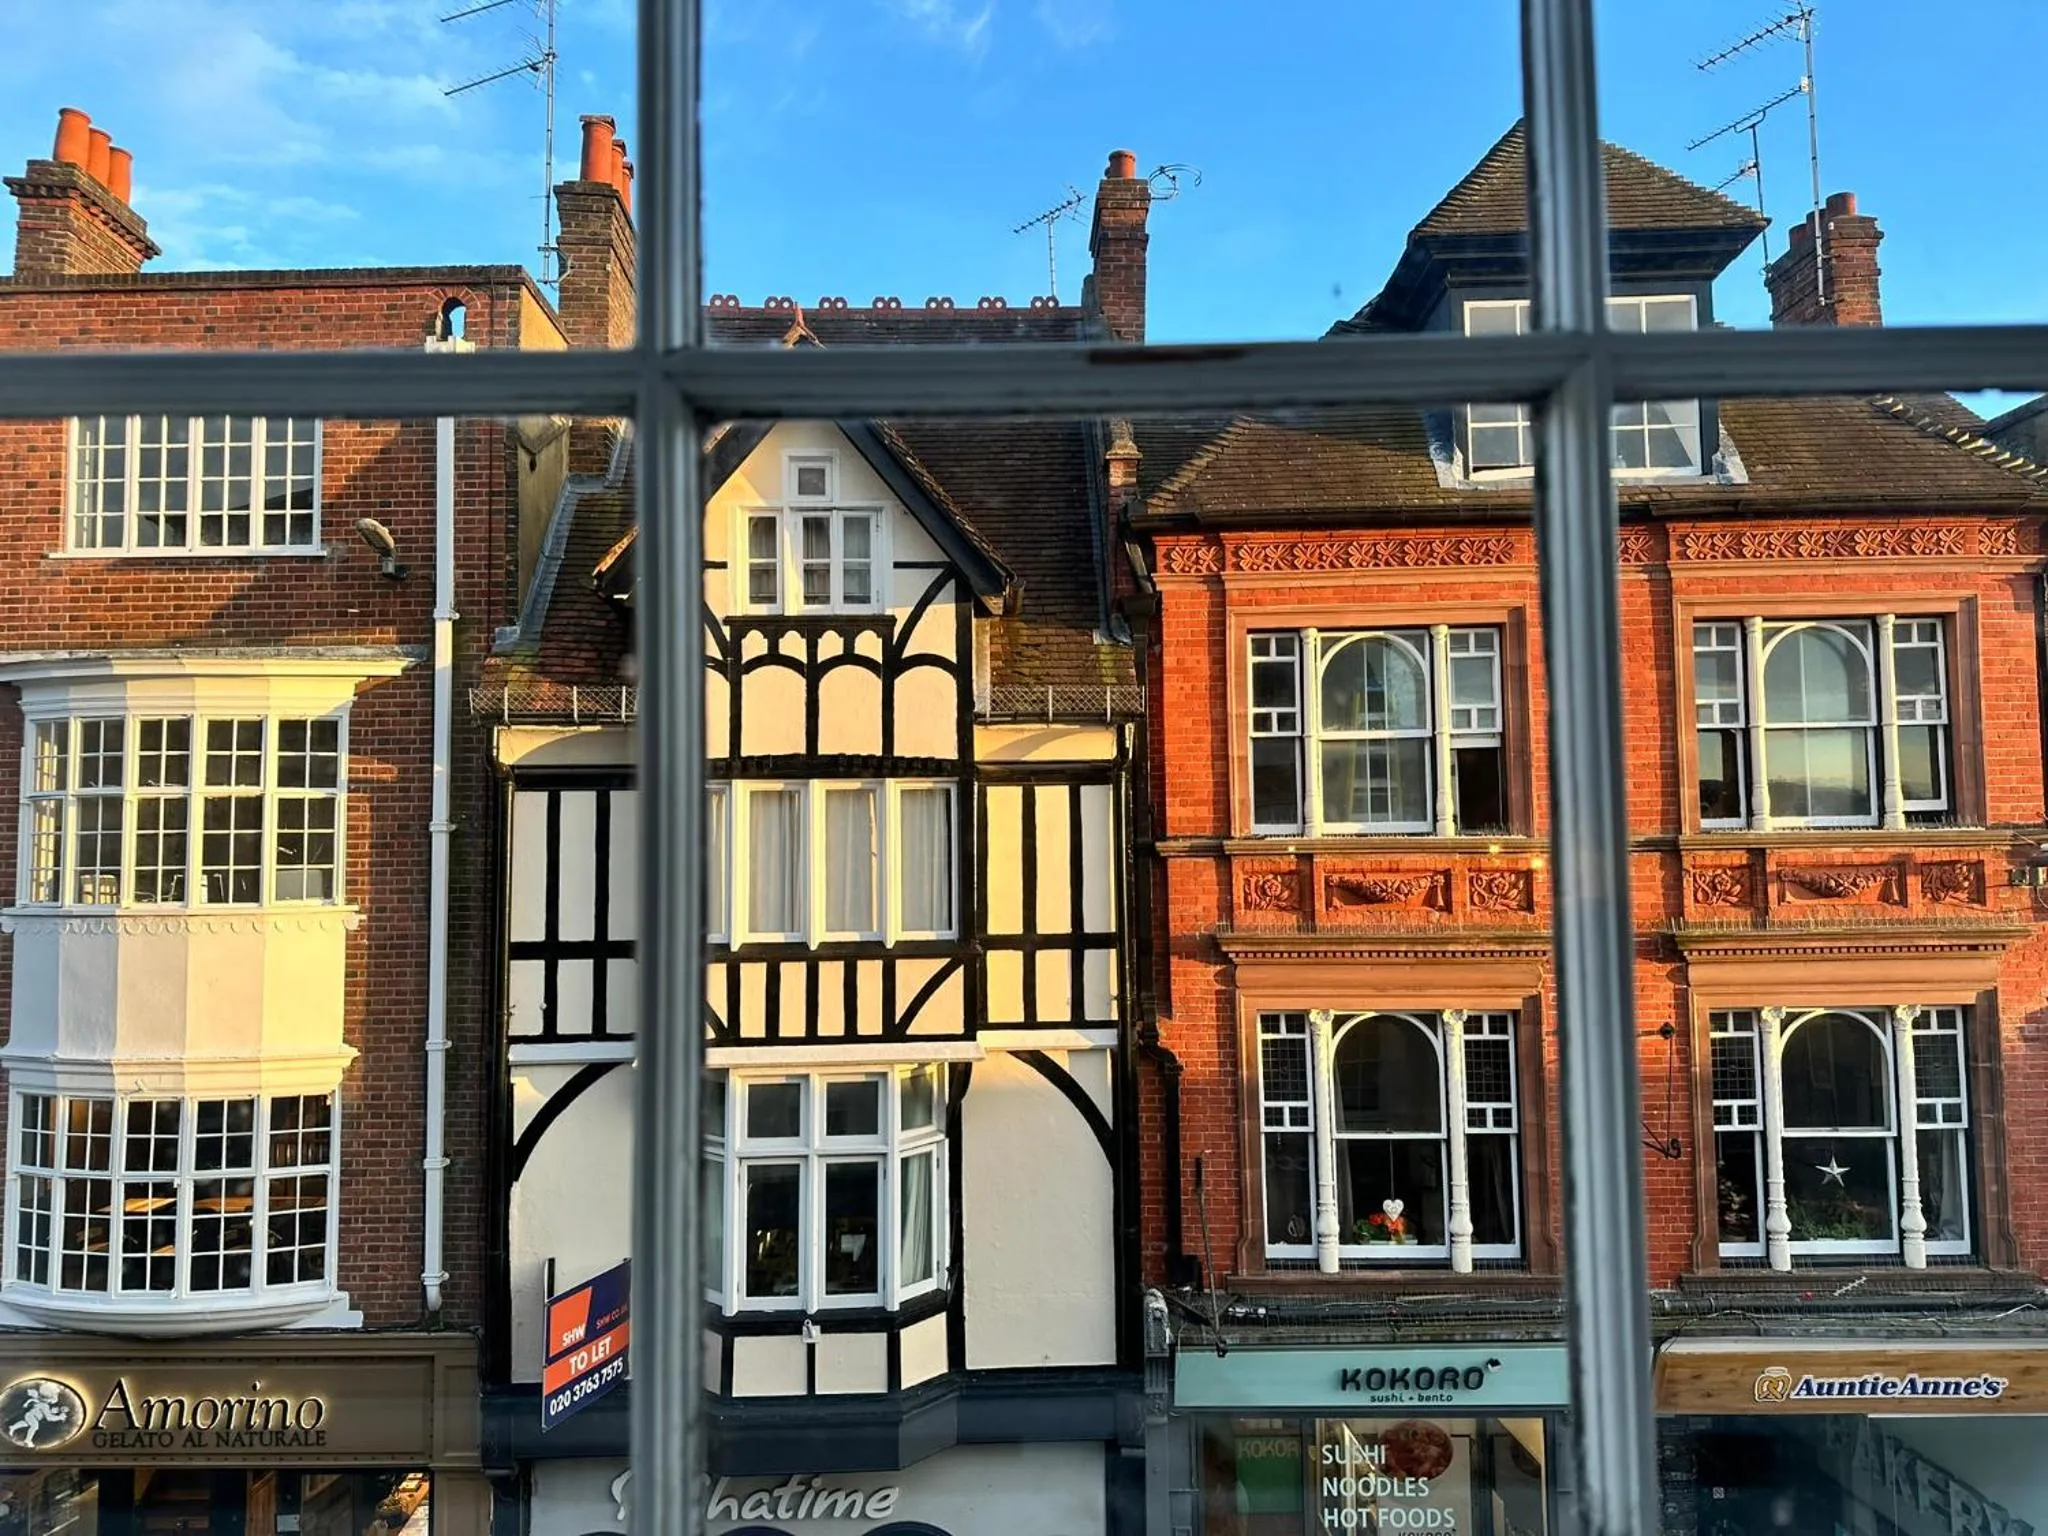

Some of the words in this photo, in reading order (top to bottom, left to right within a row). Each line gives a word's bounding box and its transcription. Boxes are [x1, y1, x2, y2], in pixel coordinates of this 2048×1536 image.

[562, 1324, 586, 1347] SHW
[569, 1351, 587, 1375] TO
[592, 1336, 612, 1363] LET
[550, 1389, 571, 1416] 020
[573, 1373, 600, 1401] 3763
[601, 1357, 623, 1384] 7575
[1340, 1366, 1485, 1391] KOKORO
[91, 1377, 327, 1431] Amorino
[1370, 1393, 1405, 1403] sushi
[1418, 1393, 1453, 1403] bento
[93, 1430, 174, 1449] GELATO
[183, 1430, 207, 1448] AL
[215, 1430, 327, 1448] NATURALE
[1238, 1439, 1299, 1459] KOKOR
[1321, 1444, 1387, 1465] SUSHI
[611, 1470, 900, 1521] hatime
[1322, 1476, 1429, 1498] NOODLES
[1323, 1507, 1372, 1529] HOT
[1378, 1507, 1456, 1529] FOODS
